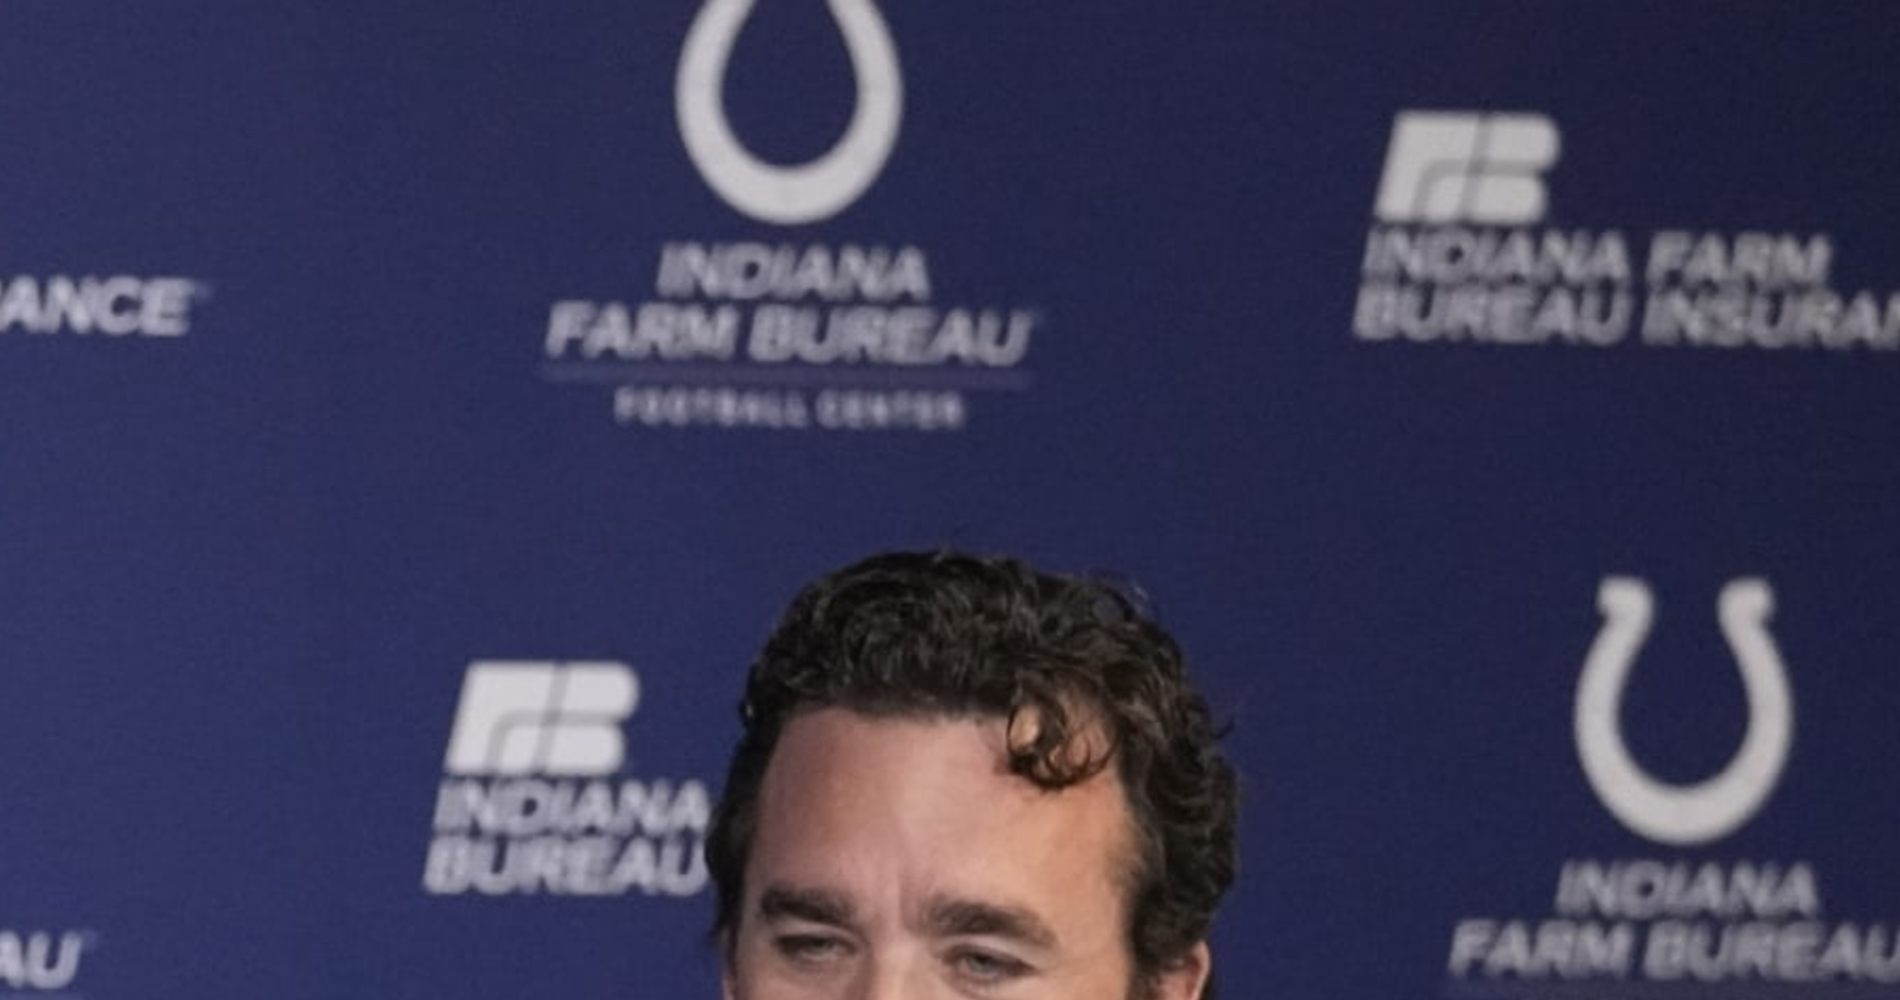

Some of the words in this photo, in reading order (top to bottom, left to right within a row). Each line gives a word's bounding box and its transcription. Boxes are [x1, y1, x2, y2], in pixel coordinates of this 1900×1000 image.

[656, 240, 931, 300] INDIANA
[1362, 224, 1632, 284] INDIANA
[1646, 229, 1833, 286] FARM
[545, 299, 740, 361] FARM
[747, 303, 1034, 367] BUREAU
[1352, 282, 1632, 347] BUREAU
[815, 387, 966, 431] CENTER
[433, 776, 711, 838] INDIANA
[422, 834, 709, 896] BUREAU
[1553, 857, 1819, 919] INDIANA
[1448, 917, 1636, 979] FARM
